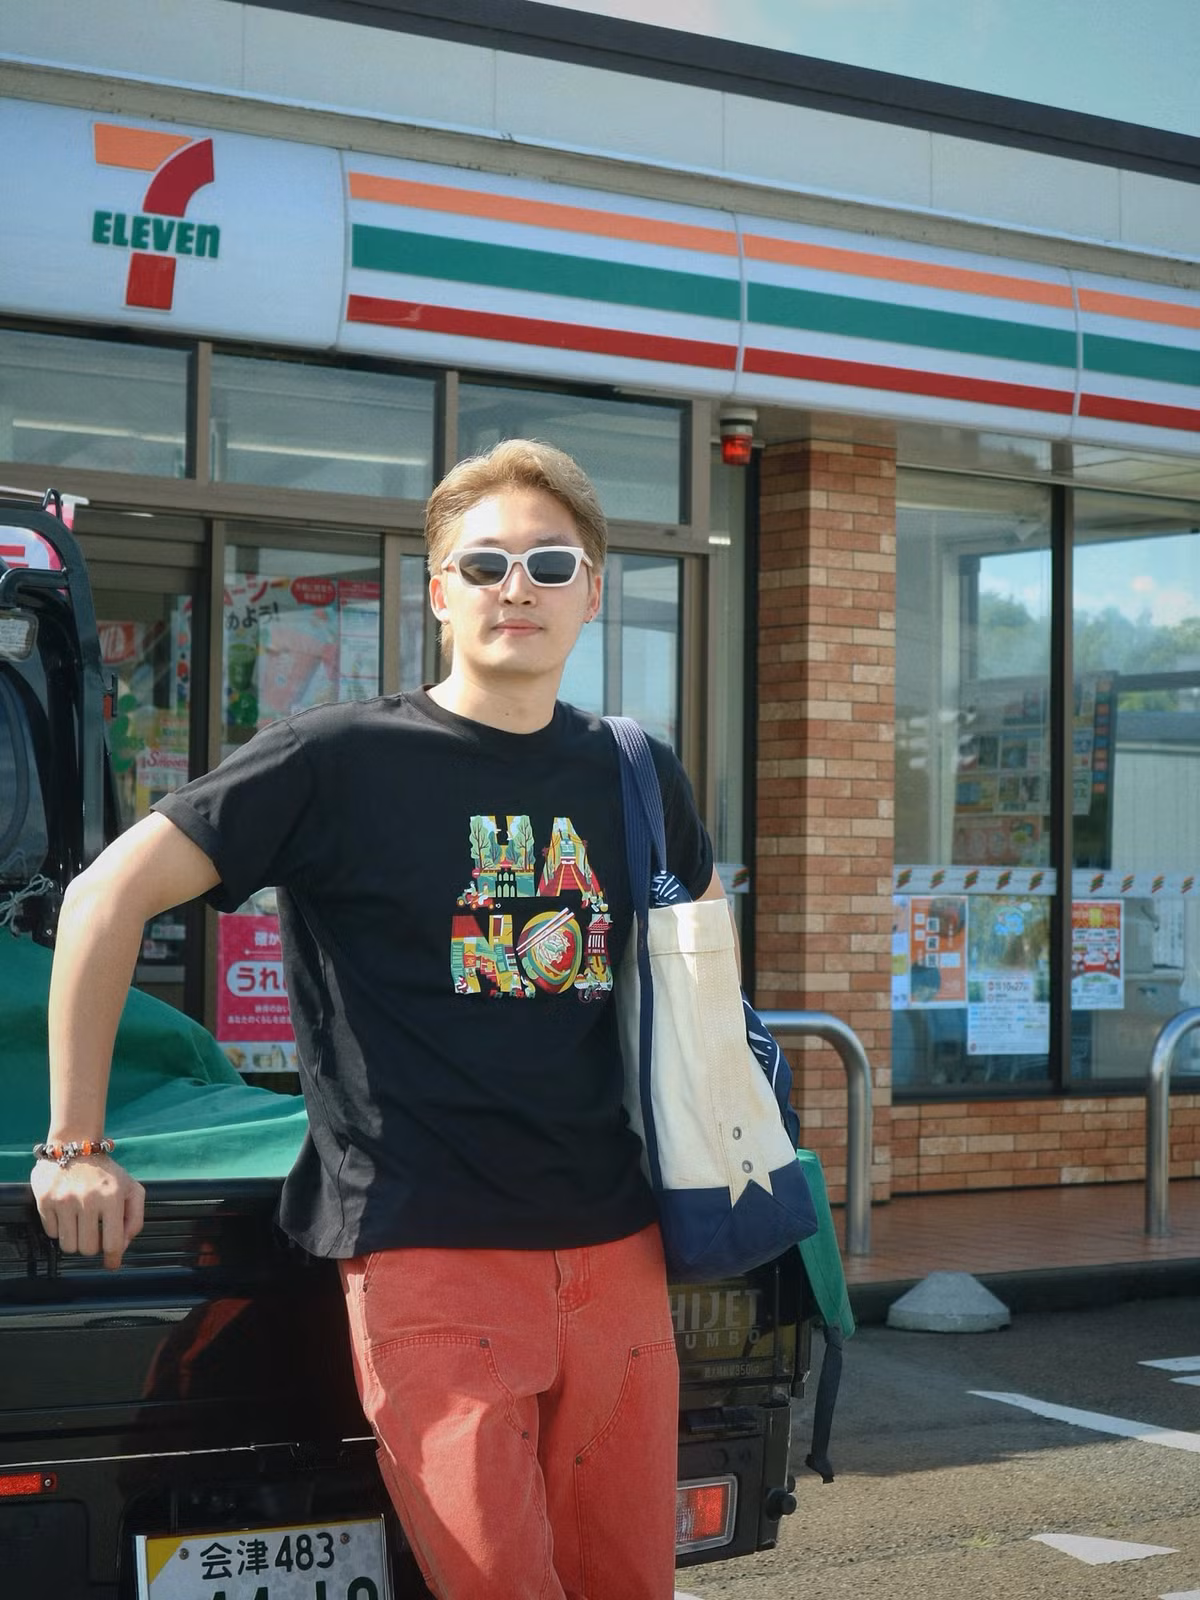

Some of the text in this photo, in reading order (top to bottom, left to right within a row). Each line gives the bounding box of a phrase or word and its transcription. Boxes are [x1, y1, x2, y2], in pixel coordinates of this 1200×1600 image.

[94, 123, 215, 311] 7
[667, 1289, 763, 1331] HIJET
[200, 1532, 335, 1580] 会津 483
